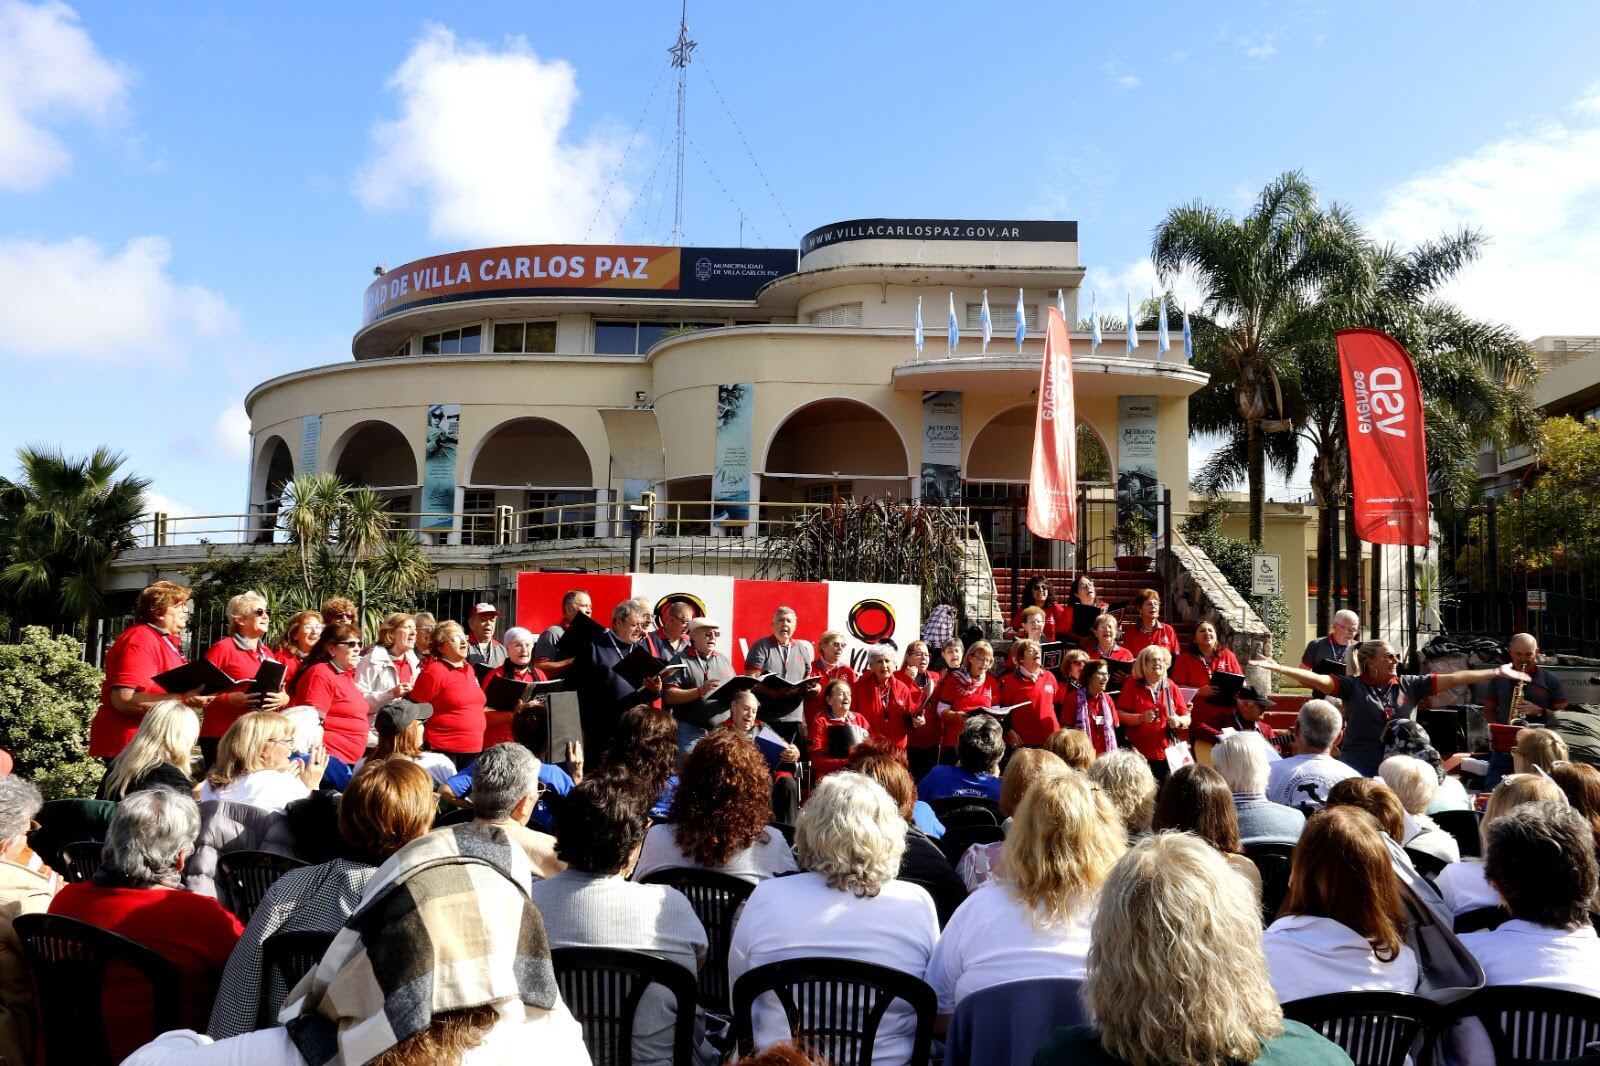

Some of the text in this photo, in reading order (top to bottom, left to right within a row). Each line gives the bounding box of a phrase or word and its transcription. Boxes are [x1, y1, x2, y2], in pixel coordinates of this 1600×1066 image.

[809, 225, 1021, 248] WWW.VILLACARLOSPAZ.GOV.AR
[390, 274, 409, 299] DE
[413, 262, 472, 292] VILLA
[479, 255, 586, 281] CARLOS
[595, 256, 649, 280] PAZ
